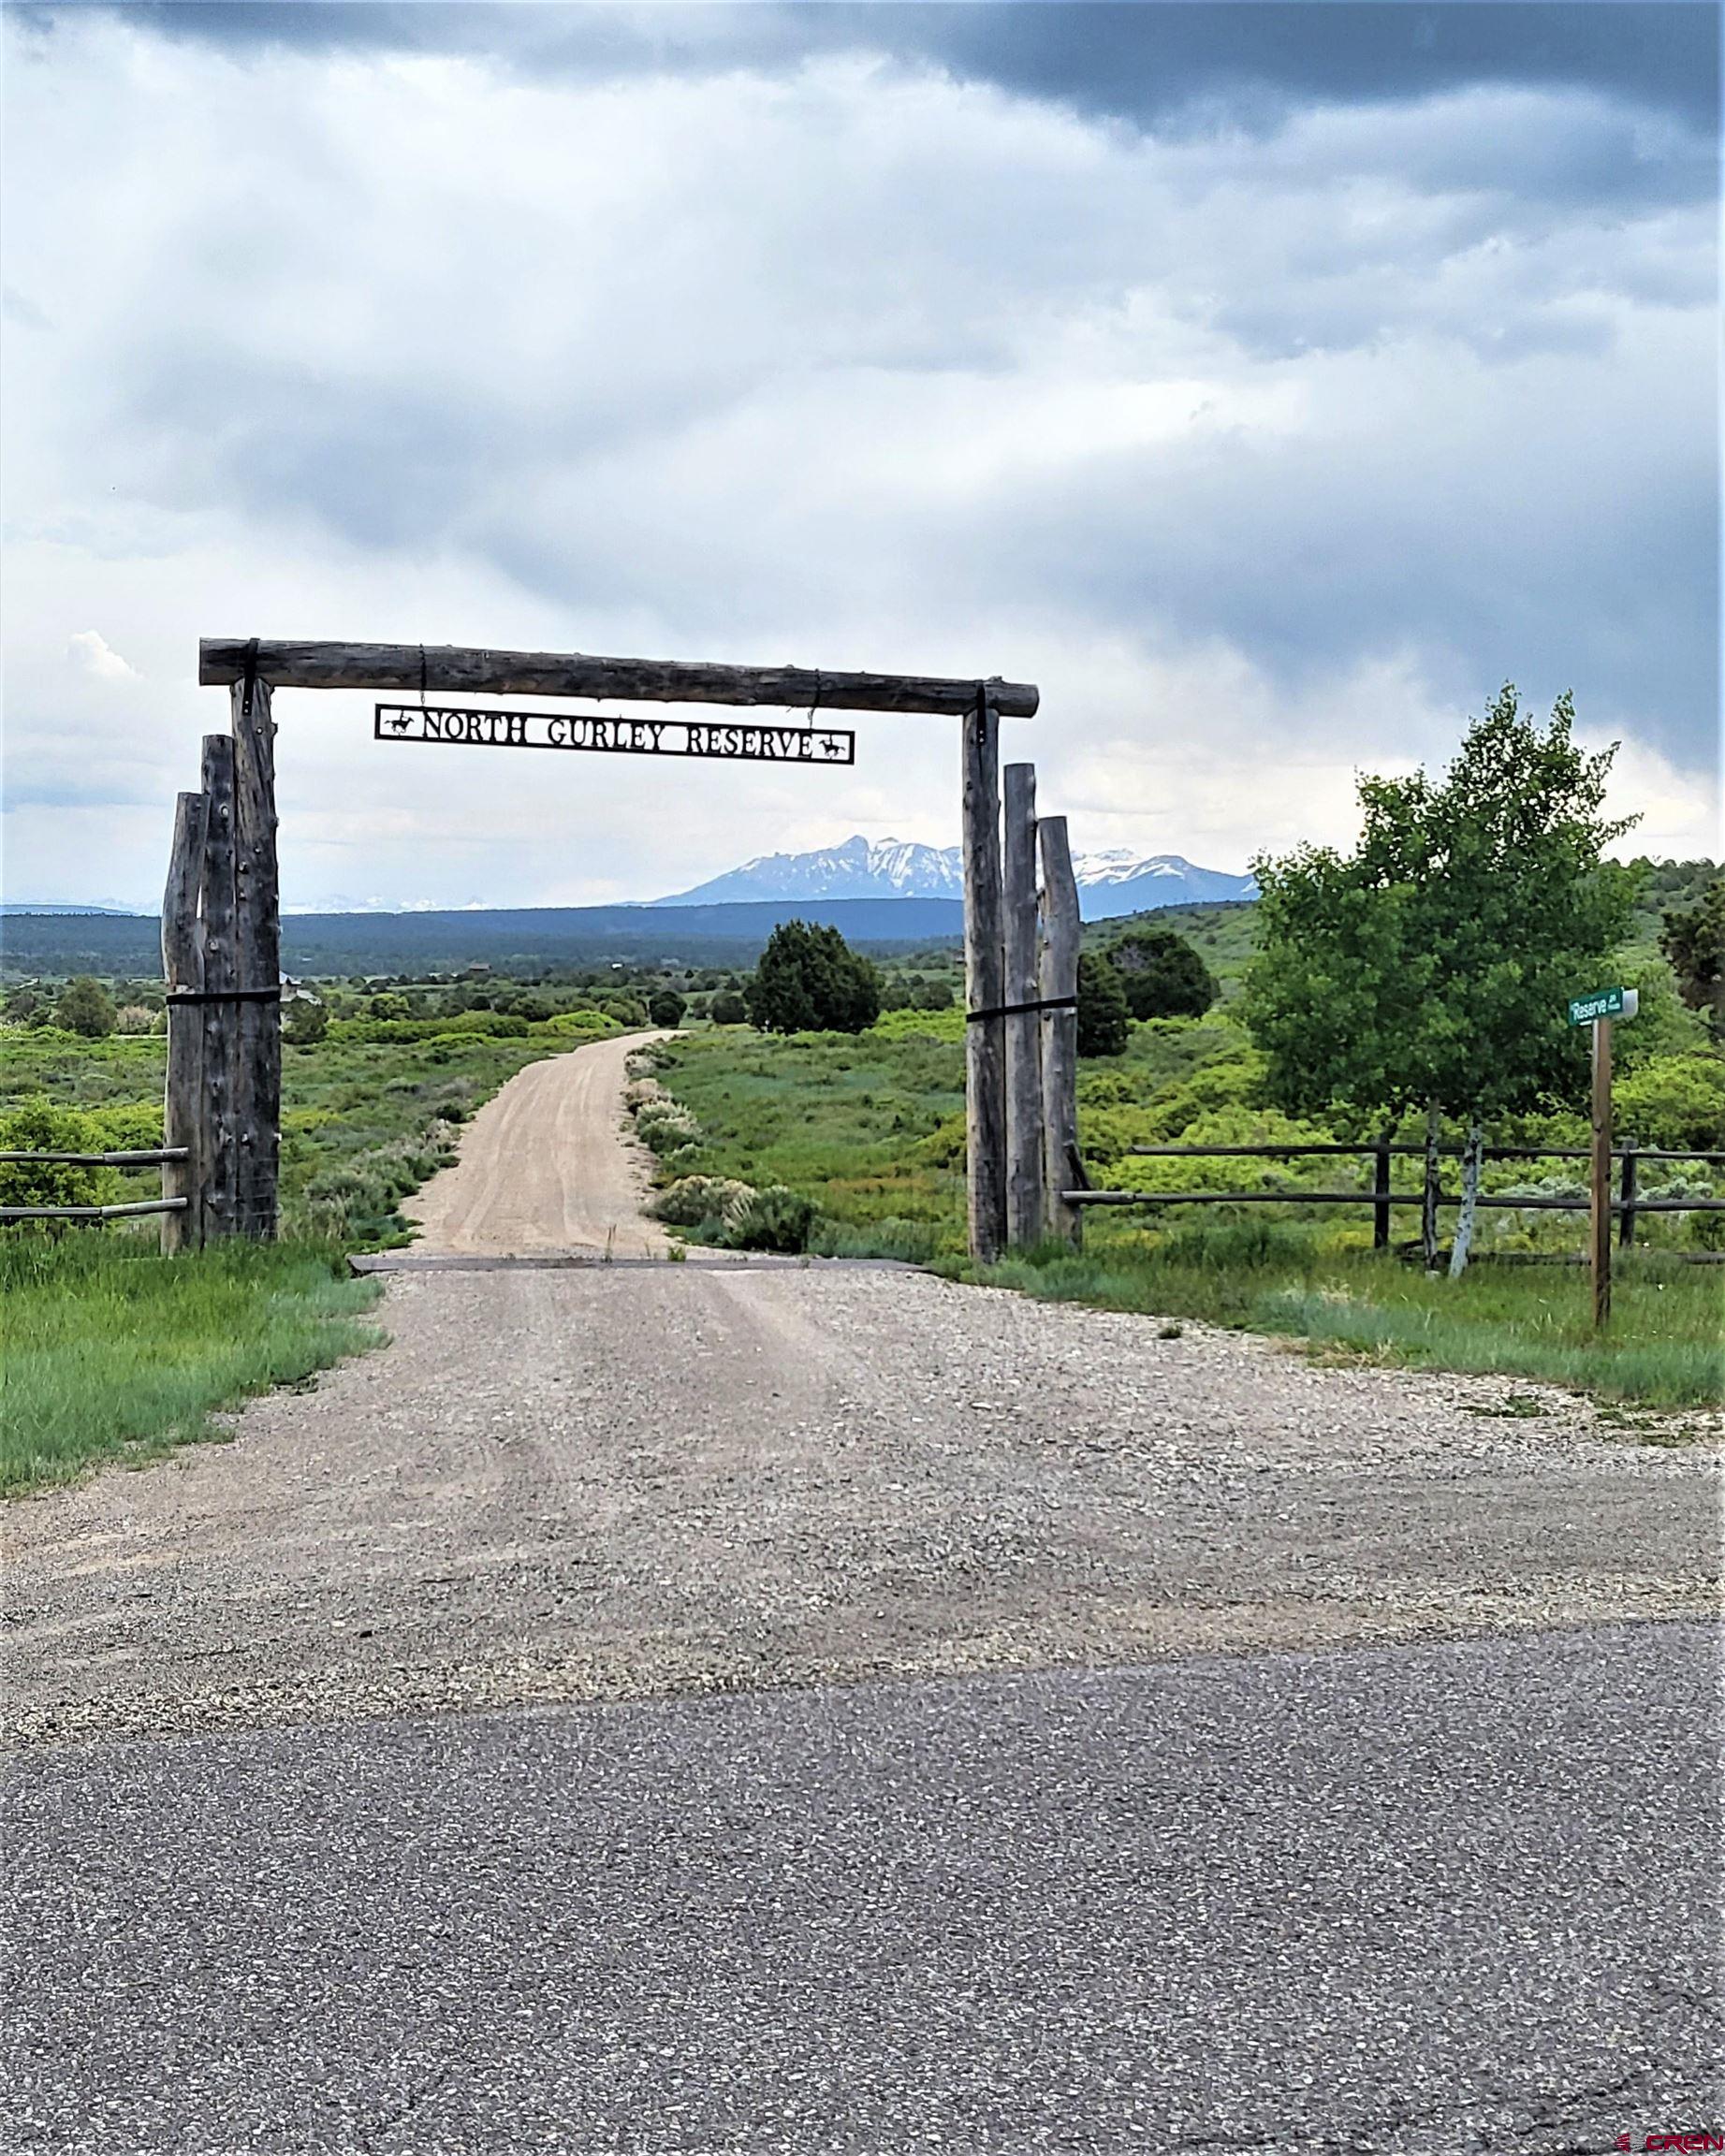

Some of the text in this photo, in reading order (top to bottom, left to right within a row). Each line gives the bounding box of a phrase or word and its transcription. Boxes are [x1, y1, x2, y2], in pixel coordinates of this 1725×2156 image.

[422, 711, 813, 759] NORTH GURLEY RESERVE
